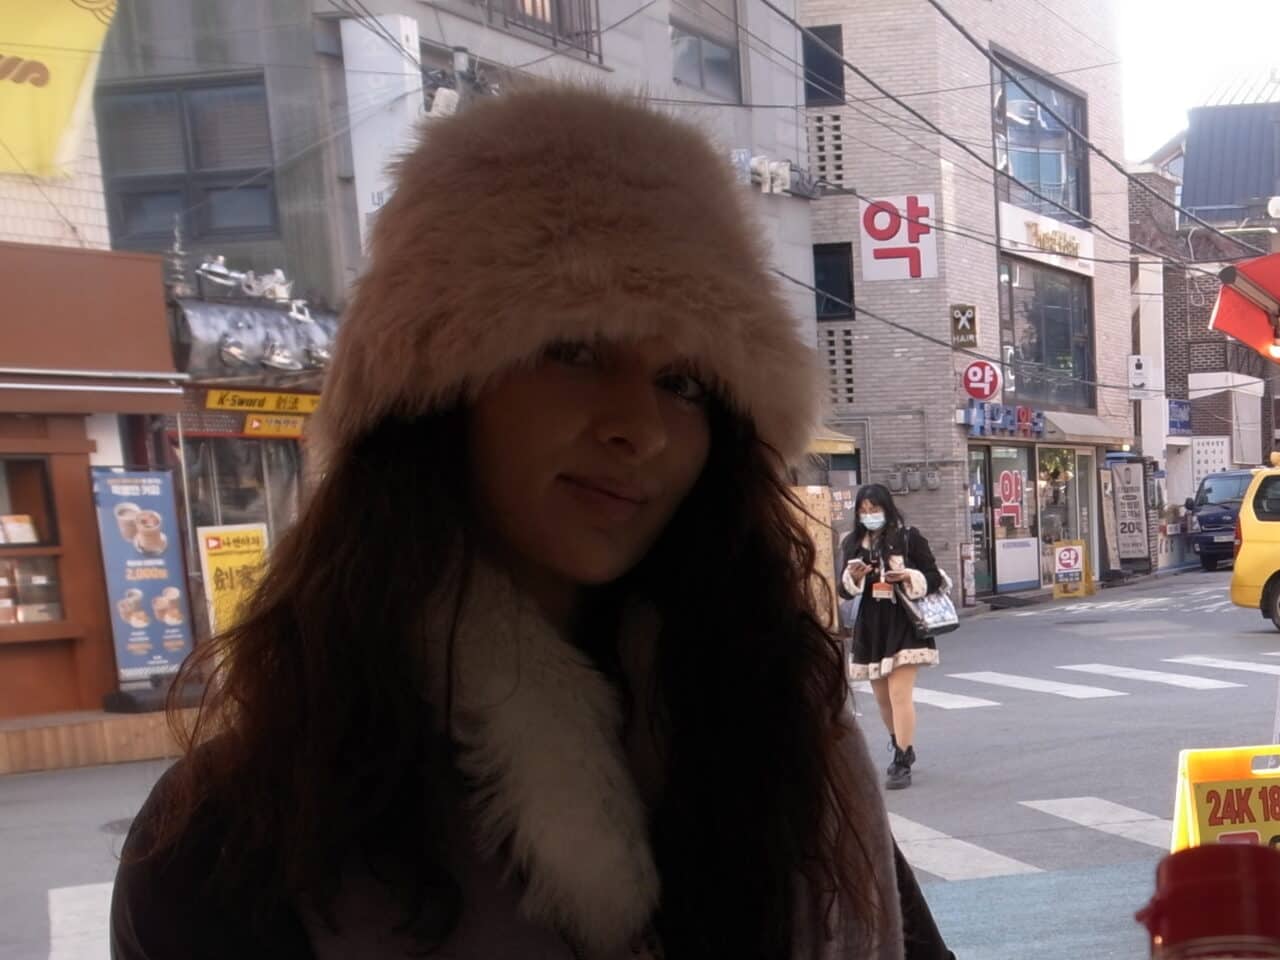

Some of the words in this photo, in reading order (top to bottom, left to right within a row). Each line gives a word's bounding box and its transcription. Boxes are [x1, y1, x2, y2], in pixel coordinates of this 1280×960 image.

[863, 196, 931, 279] 약
[952, 334, 976, 342] HAIR
[967, 365, 994, 395] 약
[217, 391, 267, 408] K-Sword
[1000, 470, 1022, 528] 약
[1060, 550, 1077, 567] 약
[1206, 786, 1256, 827] 24K
